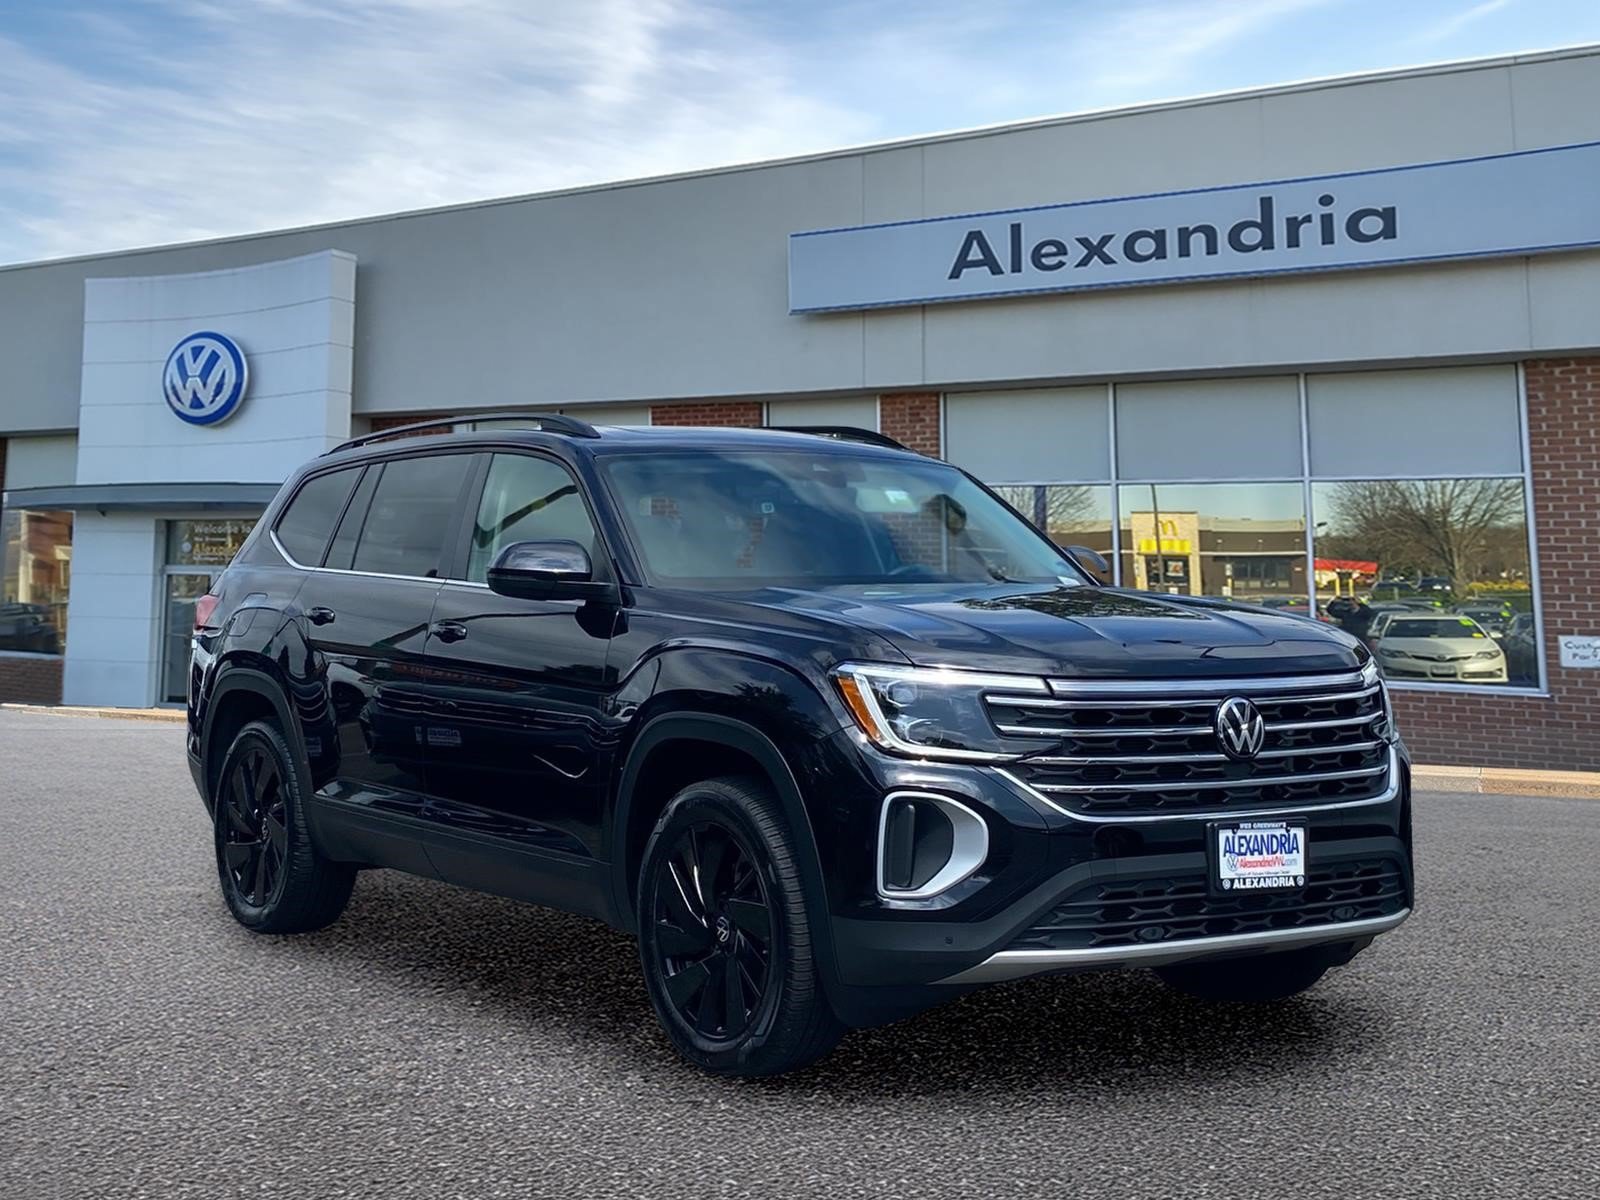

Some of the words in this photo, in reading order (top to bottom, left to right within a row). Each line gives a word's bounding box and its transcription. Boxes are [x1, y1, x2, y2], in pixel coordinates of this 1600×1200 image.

[947, 193, 1399, 281] Alexandria
[1223, 832, 1300, 857] ALEXANDRIA
[1233, 876, 1295, 889] ALEXANDRIA
